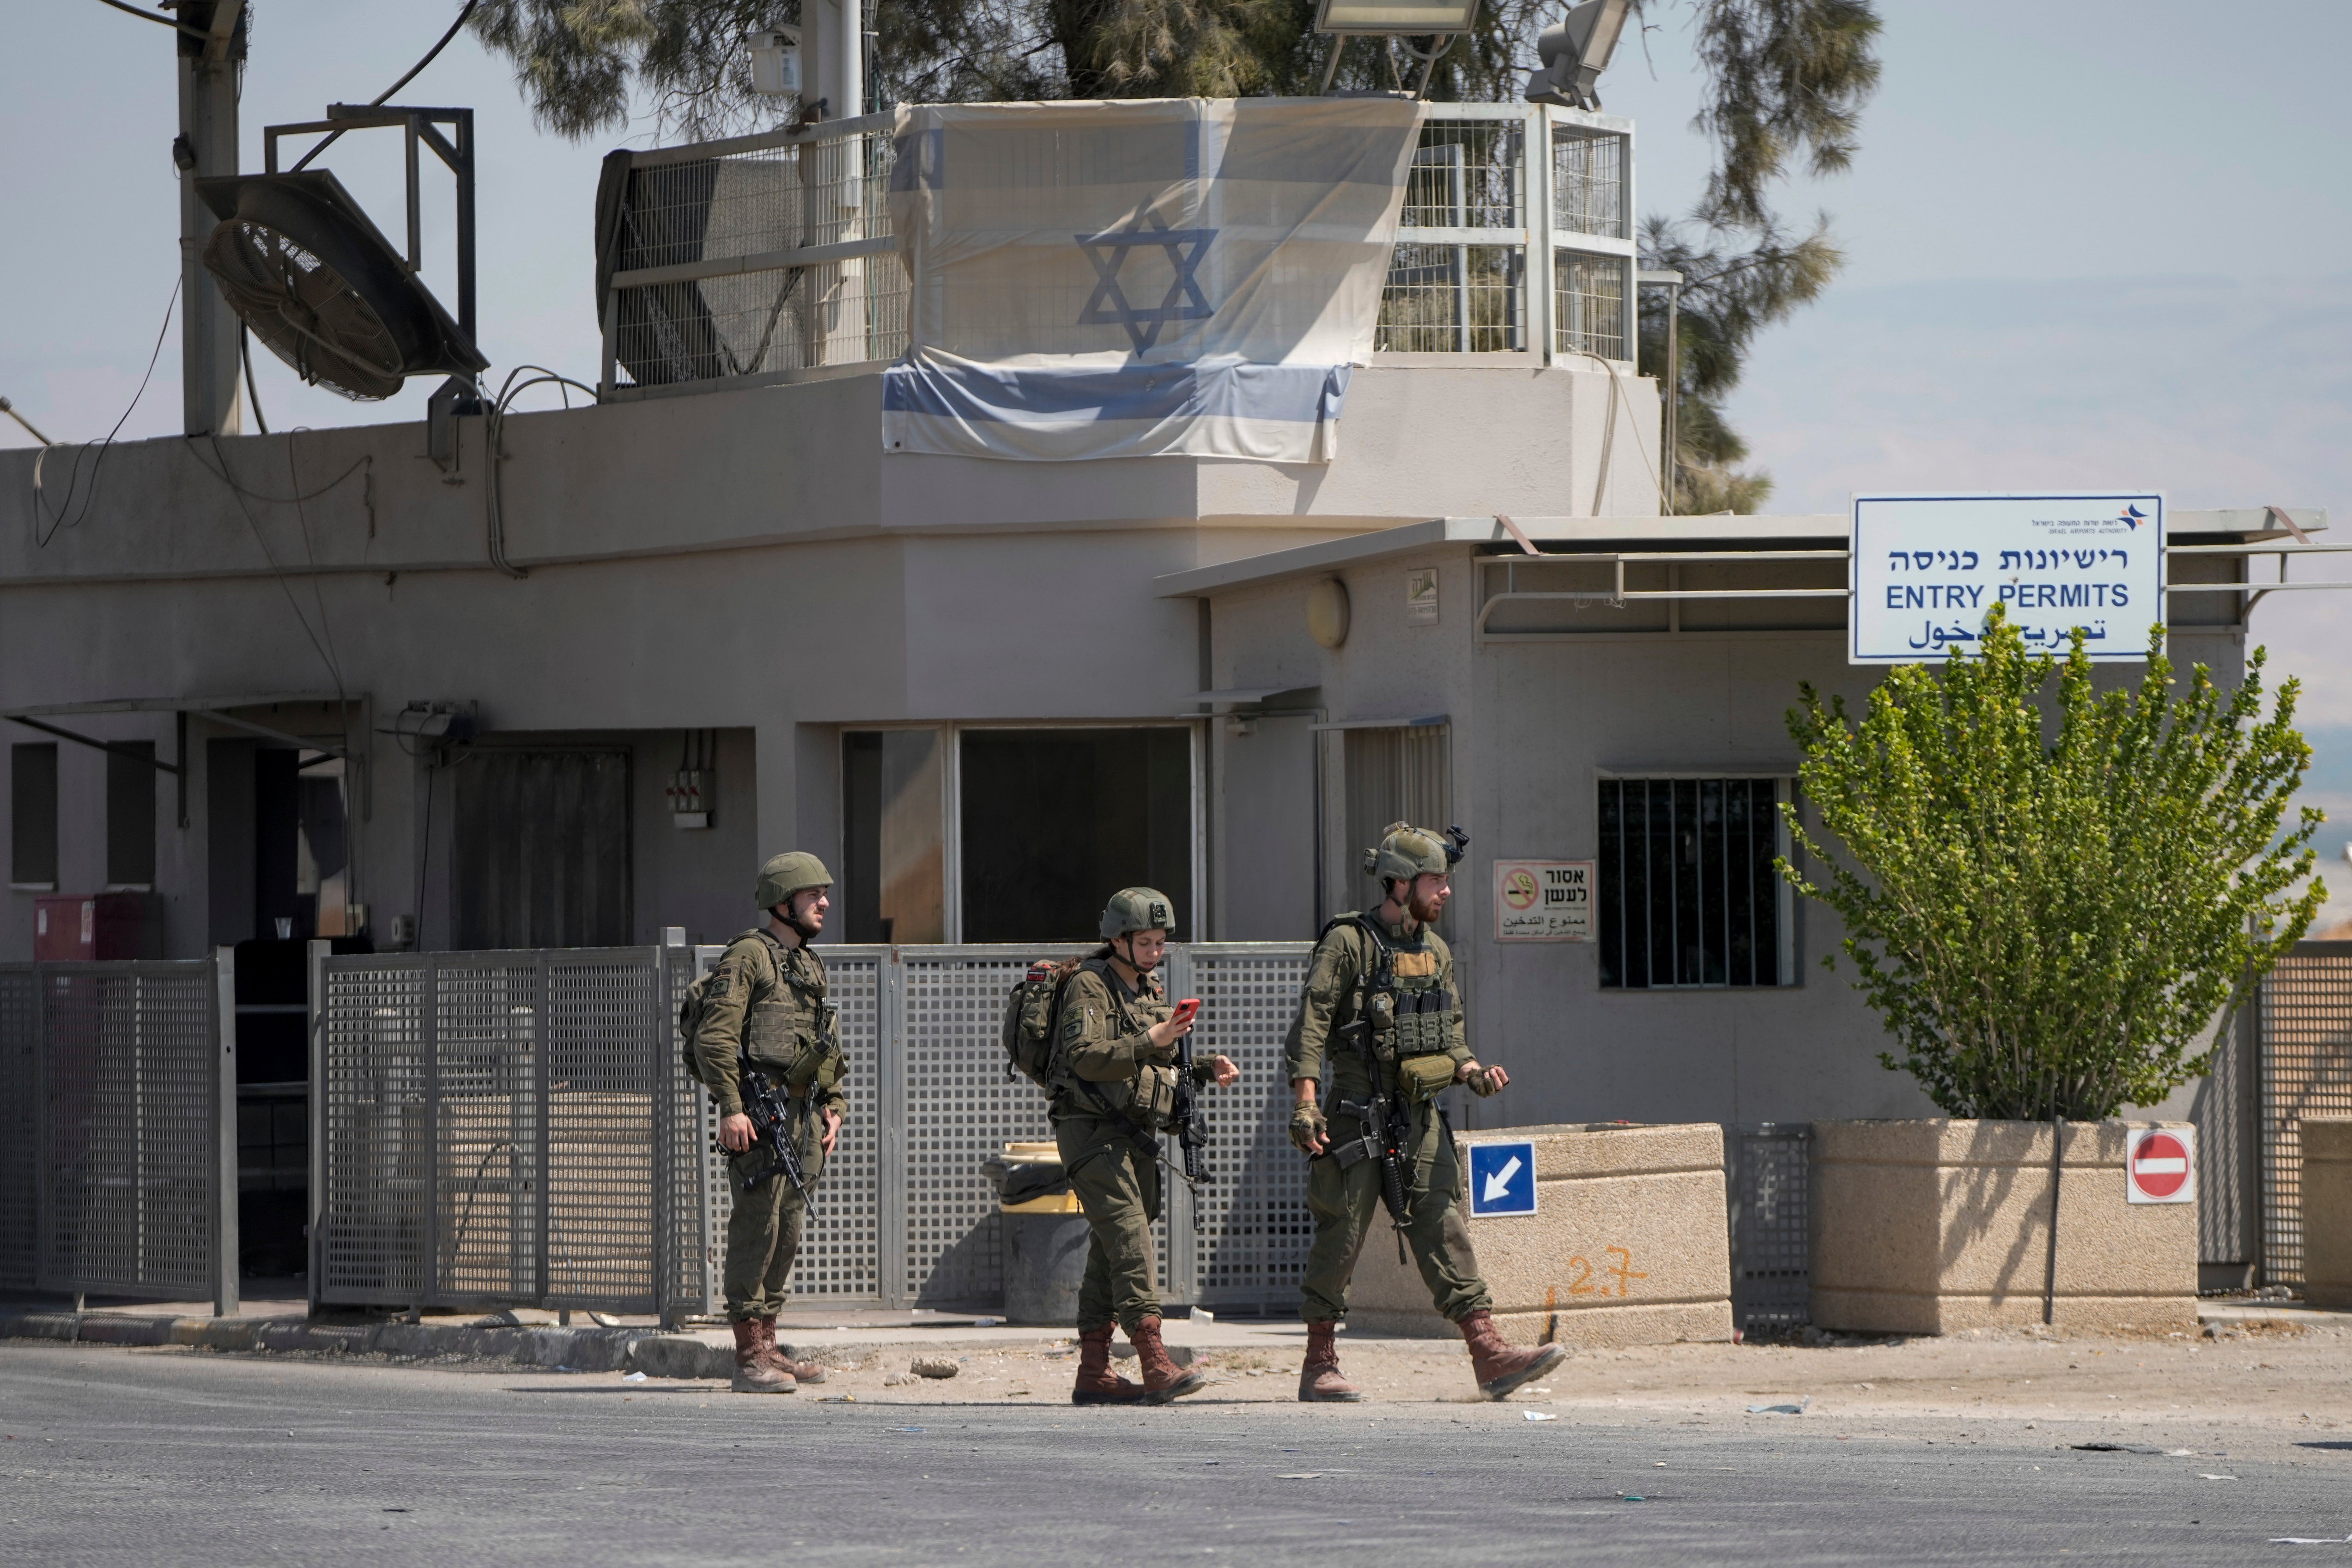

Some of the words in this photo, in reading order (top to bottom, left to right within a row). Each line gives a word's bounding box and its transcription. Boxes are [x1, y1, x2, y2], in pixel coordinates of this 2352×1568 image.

[1888, 550, 1979, 571] כניסה
[1998, 549, 2128, 570] רישיונות
[1886, 585, 1985, 609] ENTRY
[1998, 584, 2129, 608] PERMITS
[1546, 870, 1584, 884] אסור
[1544, 886, 1587, 905] לעשן
[1549, 916, 1586, 928] ممنوع
